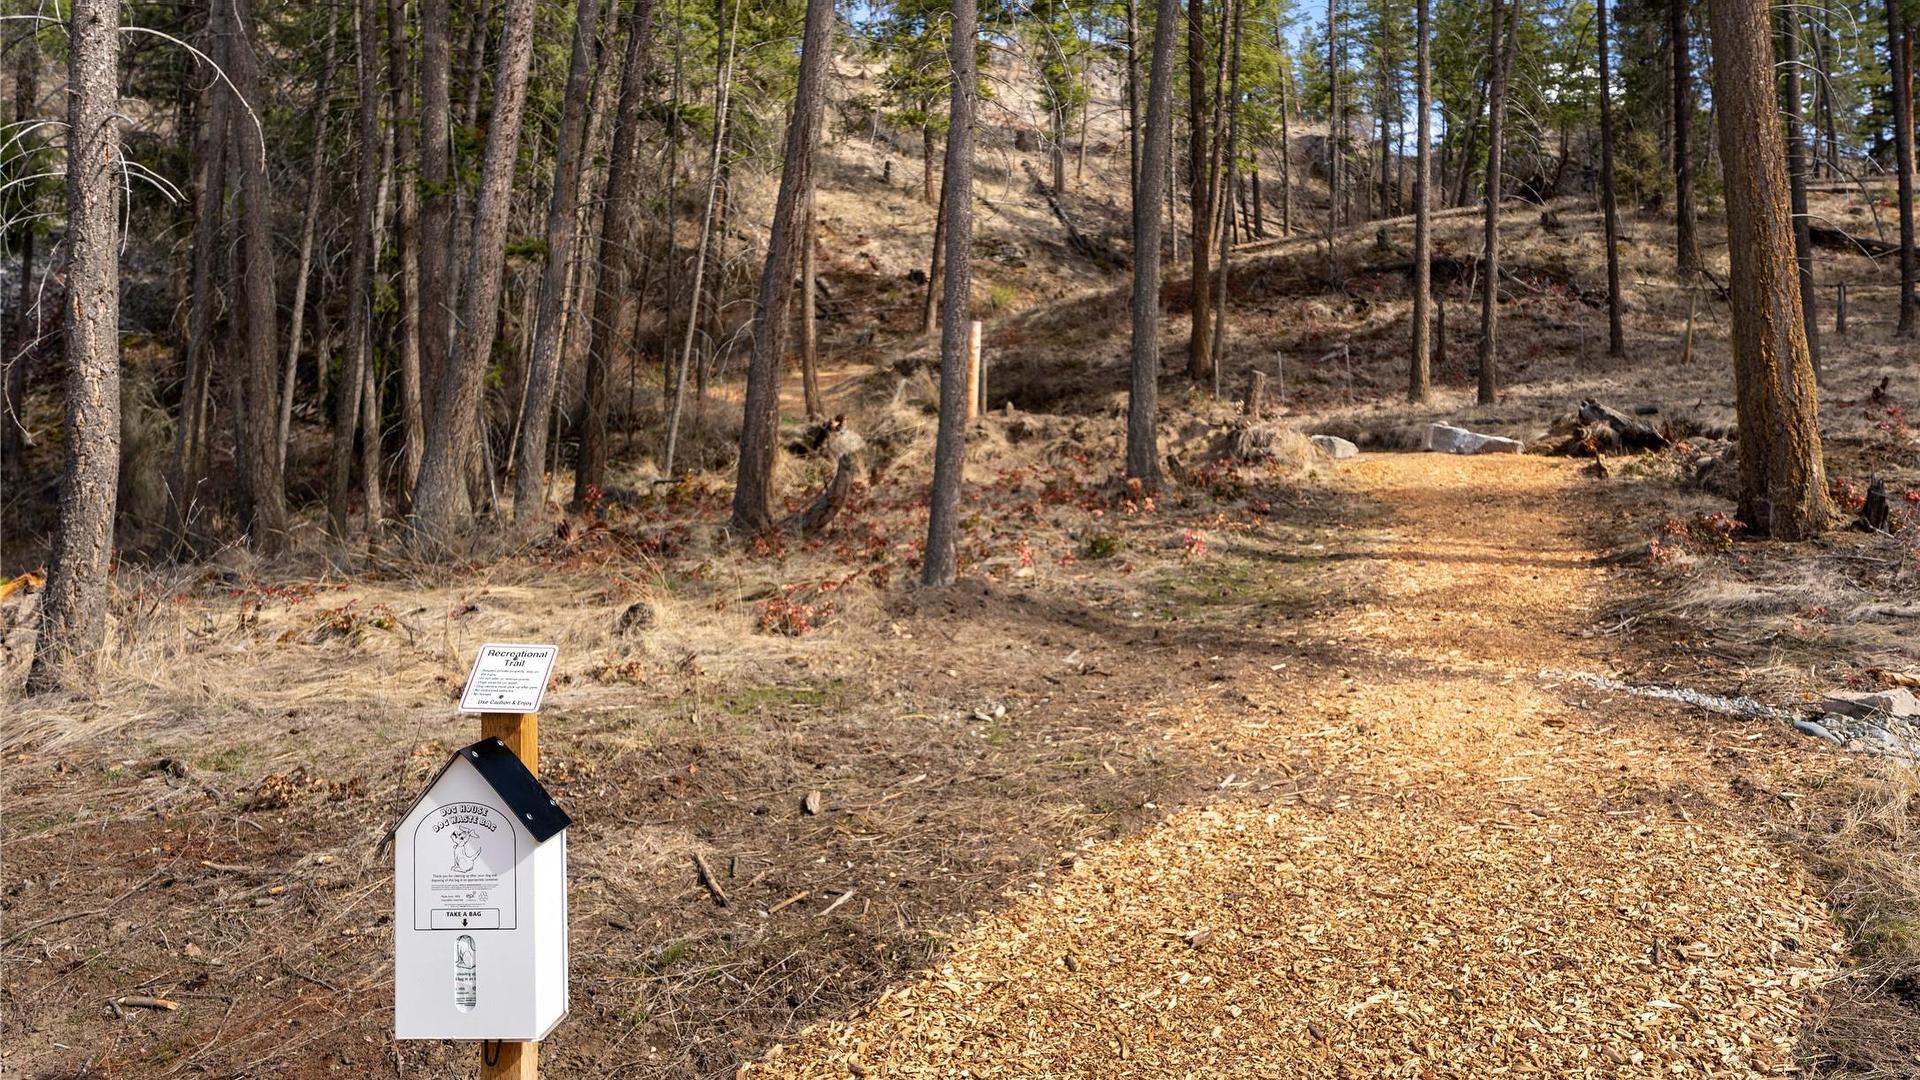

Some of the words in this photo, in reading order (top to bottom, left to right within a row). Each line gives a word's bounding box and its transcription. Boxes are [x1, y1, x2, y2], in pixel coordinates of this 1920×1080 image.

[488, 650, 548, 658] Recreational
[440, 806, 457, 817] DOG
[460, 805, 488, 817] HOUSE
[432, 819, 450, 832] DOG
[450, 815, 478, 824] WASTE
[479, 817, 497, 832] BAG
